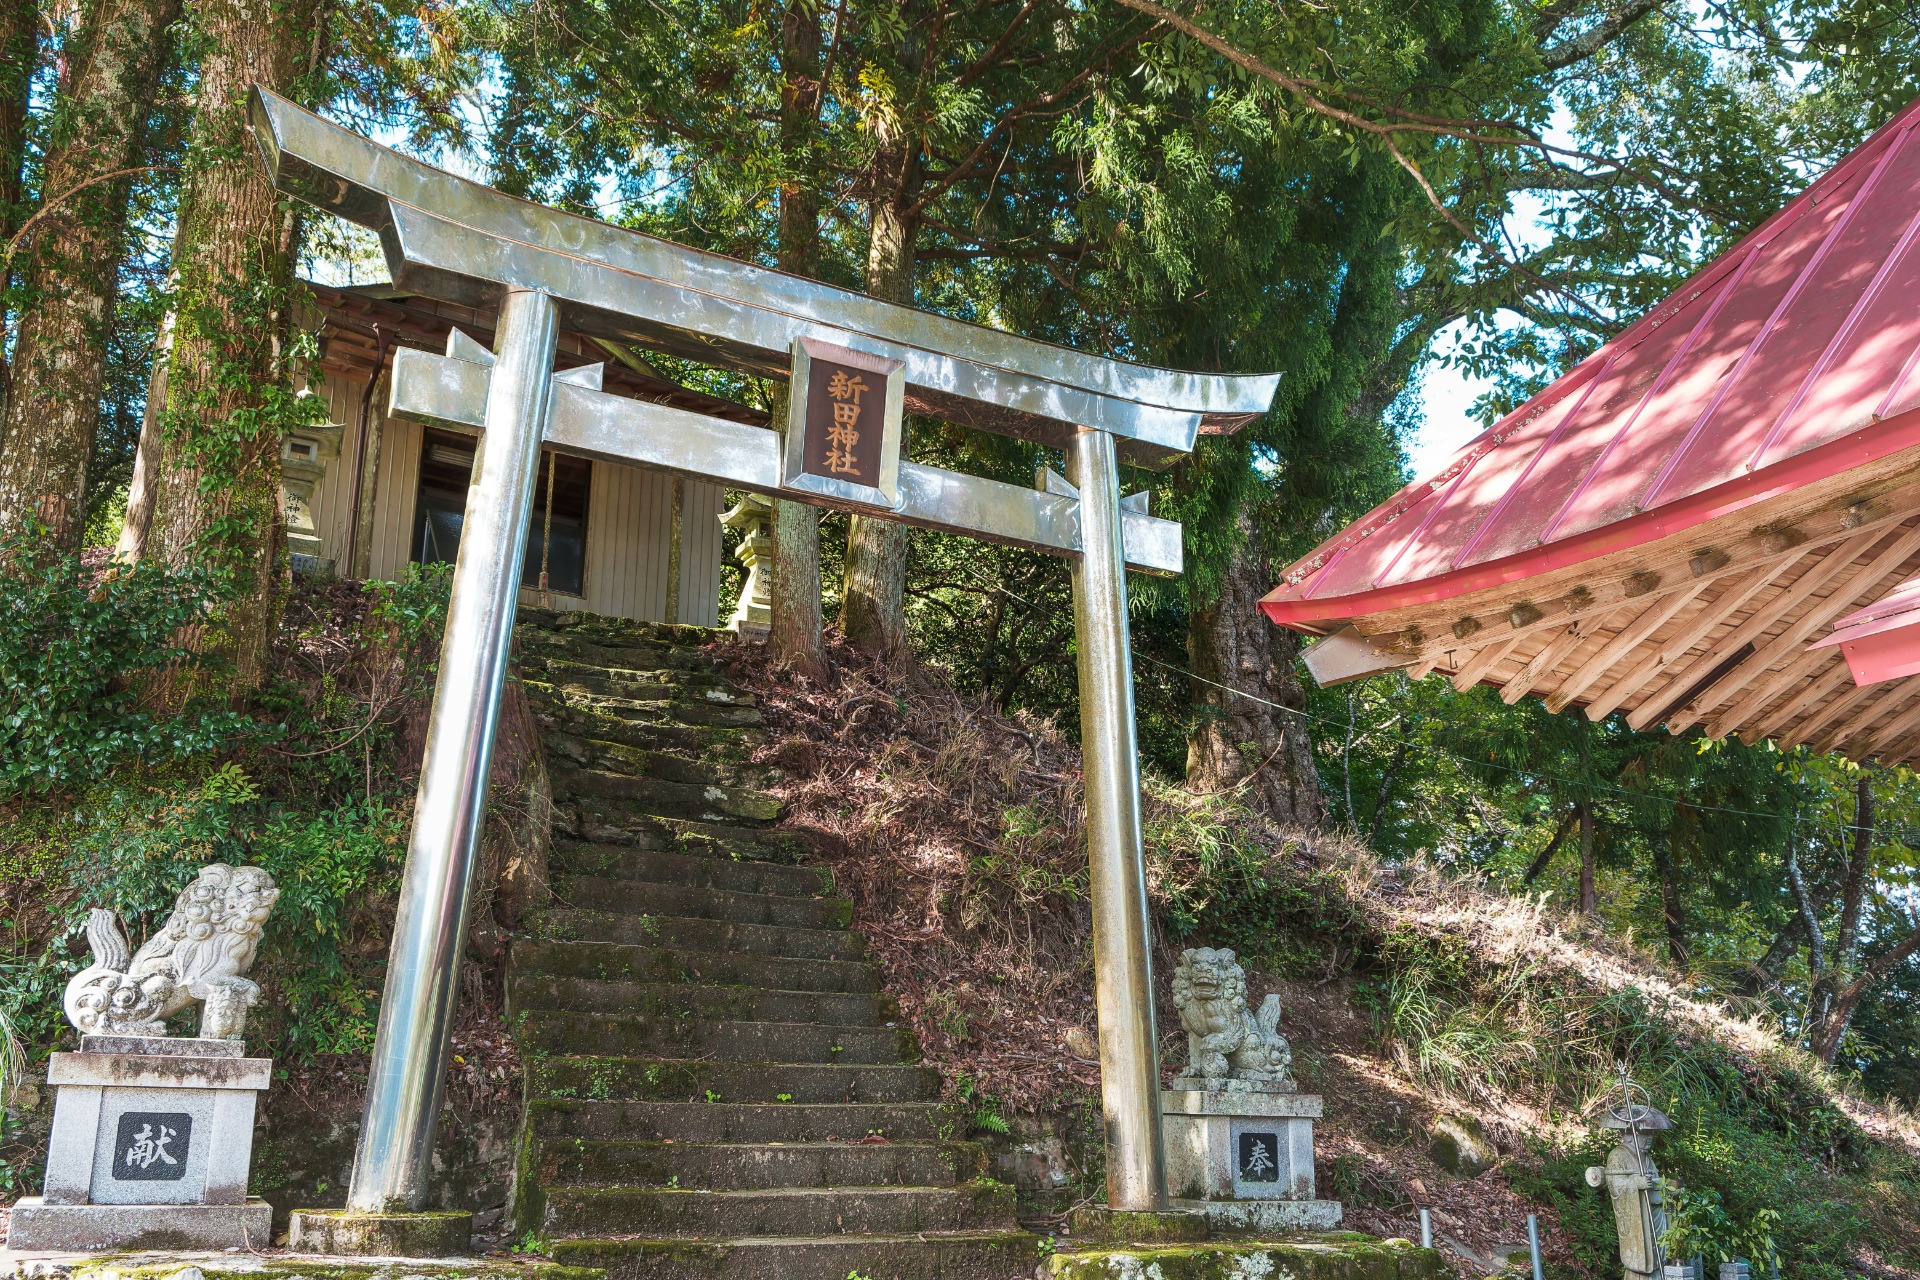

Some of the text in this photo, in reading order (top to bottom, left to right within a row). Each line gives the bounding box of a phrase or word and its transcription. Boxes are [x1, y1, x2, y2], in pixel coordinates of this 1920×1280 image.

[823, 370, 869, 476] 新田神社
[126, 1124, 178, 1169] 献
[1246, 1140, 1274, 1177] 奉
